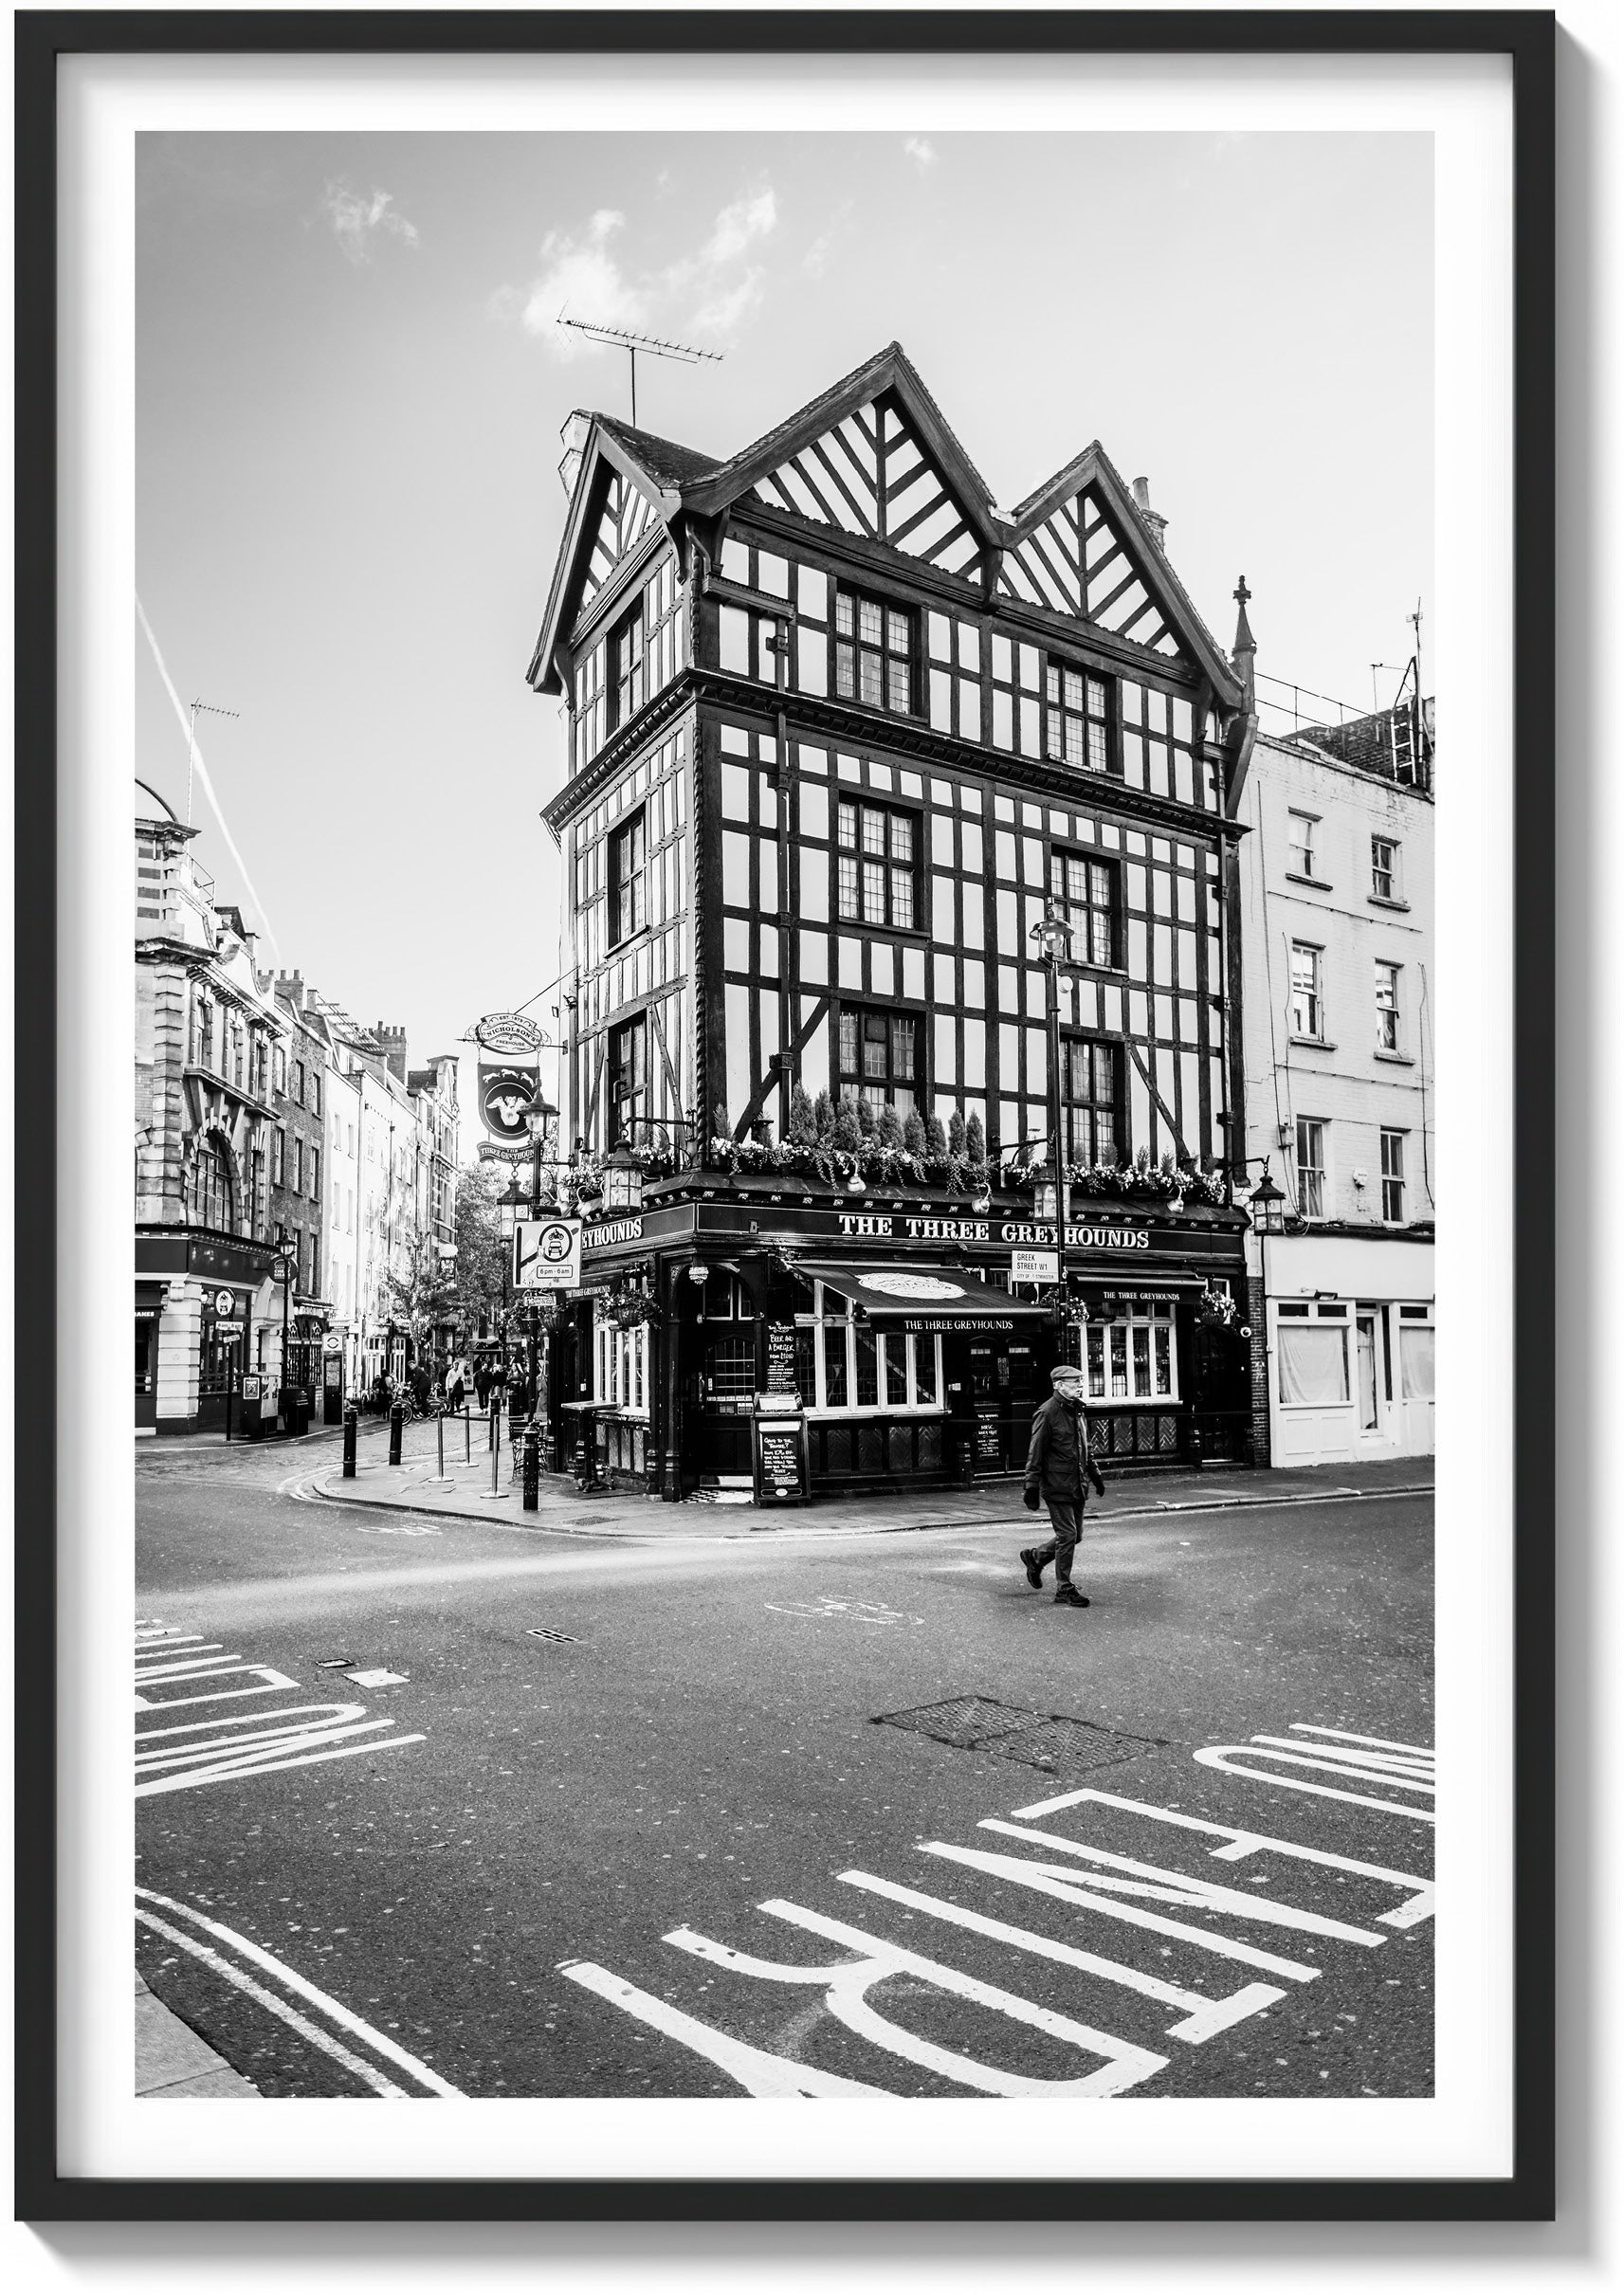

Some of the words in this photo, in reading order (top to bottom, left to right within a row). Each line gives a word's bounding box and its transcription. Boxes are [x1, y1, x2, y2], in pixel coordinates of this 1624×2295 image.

[486, 1027, 538, 1043] NICHOLSON'S
[501, 1148, 542, 1160] GREYHOUN
[582, 1218, 642, 1249] EYHOUNDS
[838, 1214, 893, 1237] THE
[905, 1218, 990, 1241] THREE
[1001, 1223, 1150, 1249] GREYHOUNDS
[1016, 1253, 1035, 1262] GREEK
[1016, 1262, 1037, 1270] STREET
[1039, 1263, 1048, 1271] W1
[1118, 1291, 1138, 1300] THREE
[1140, 1292, 1180, 1301] GREYHOUNDS
[903, 1320, 922, 1330] THE
[923, 1320, 953, 1330] THREE
[954, 1320, 1013, 1330] GREYHOUNDS
[561, 1788, 1435, 2099] ENTRY
